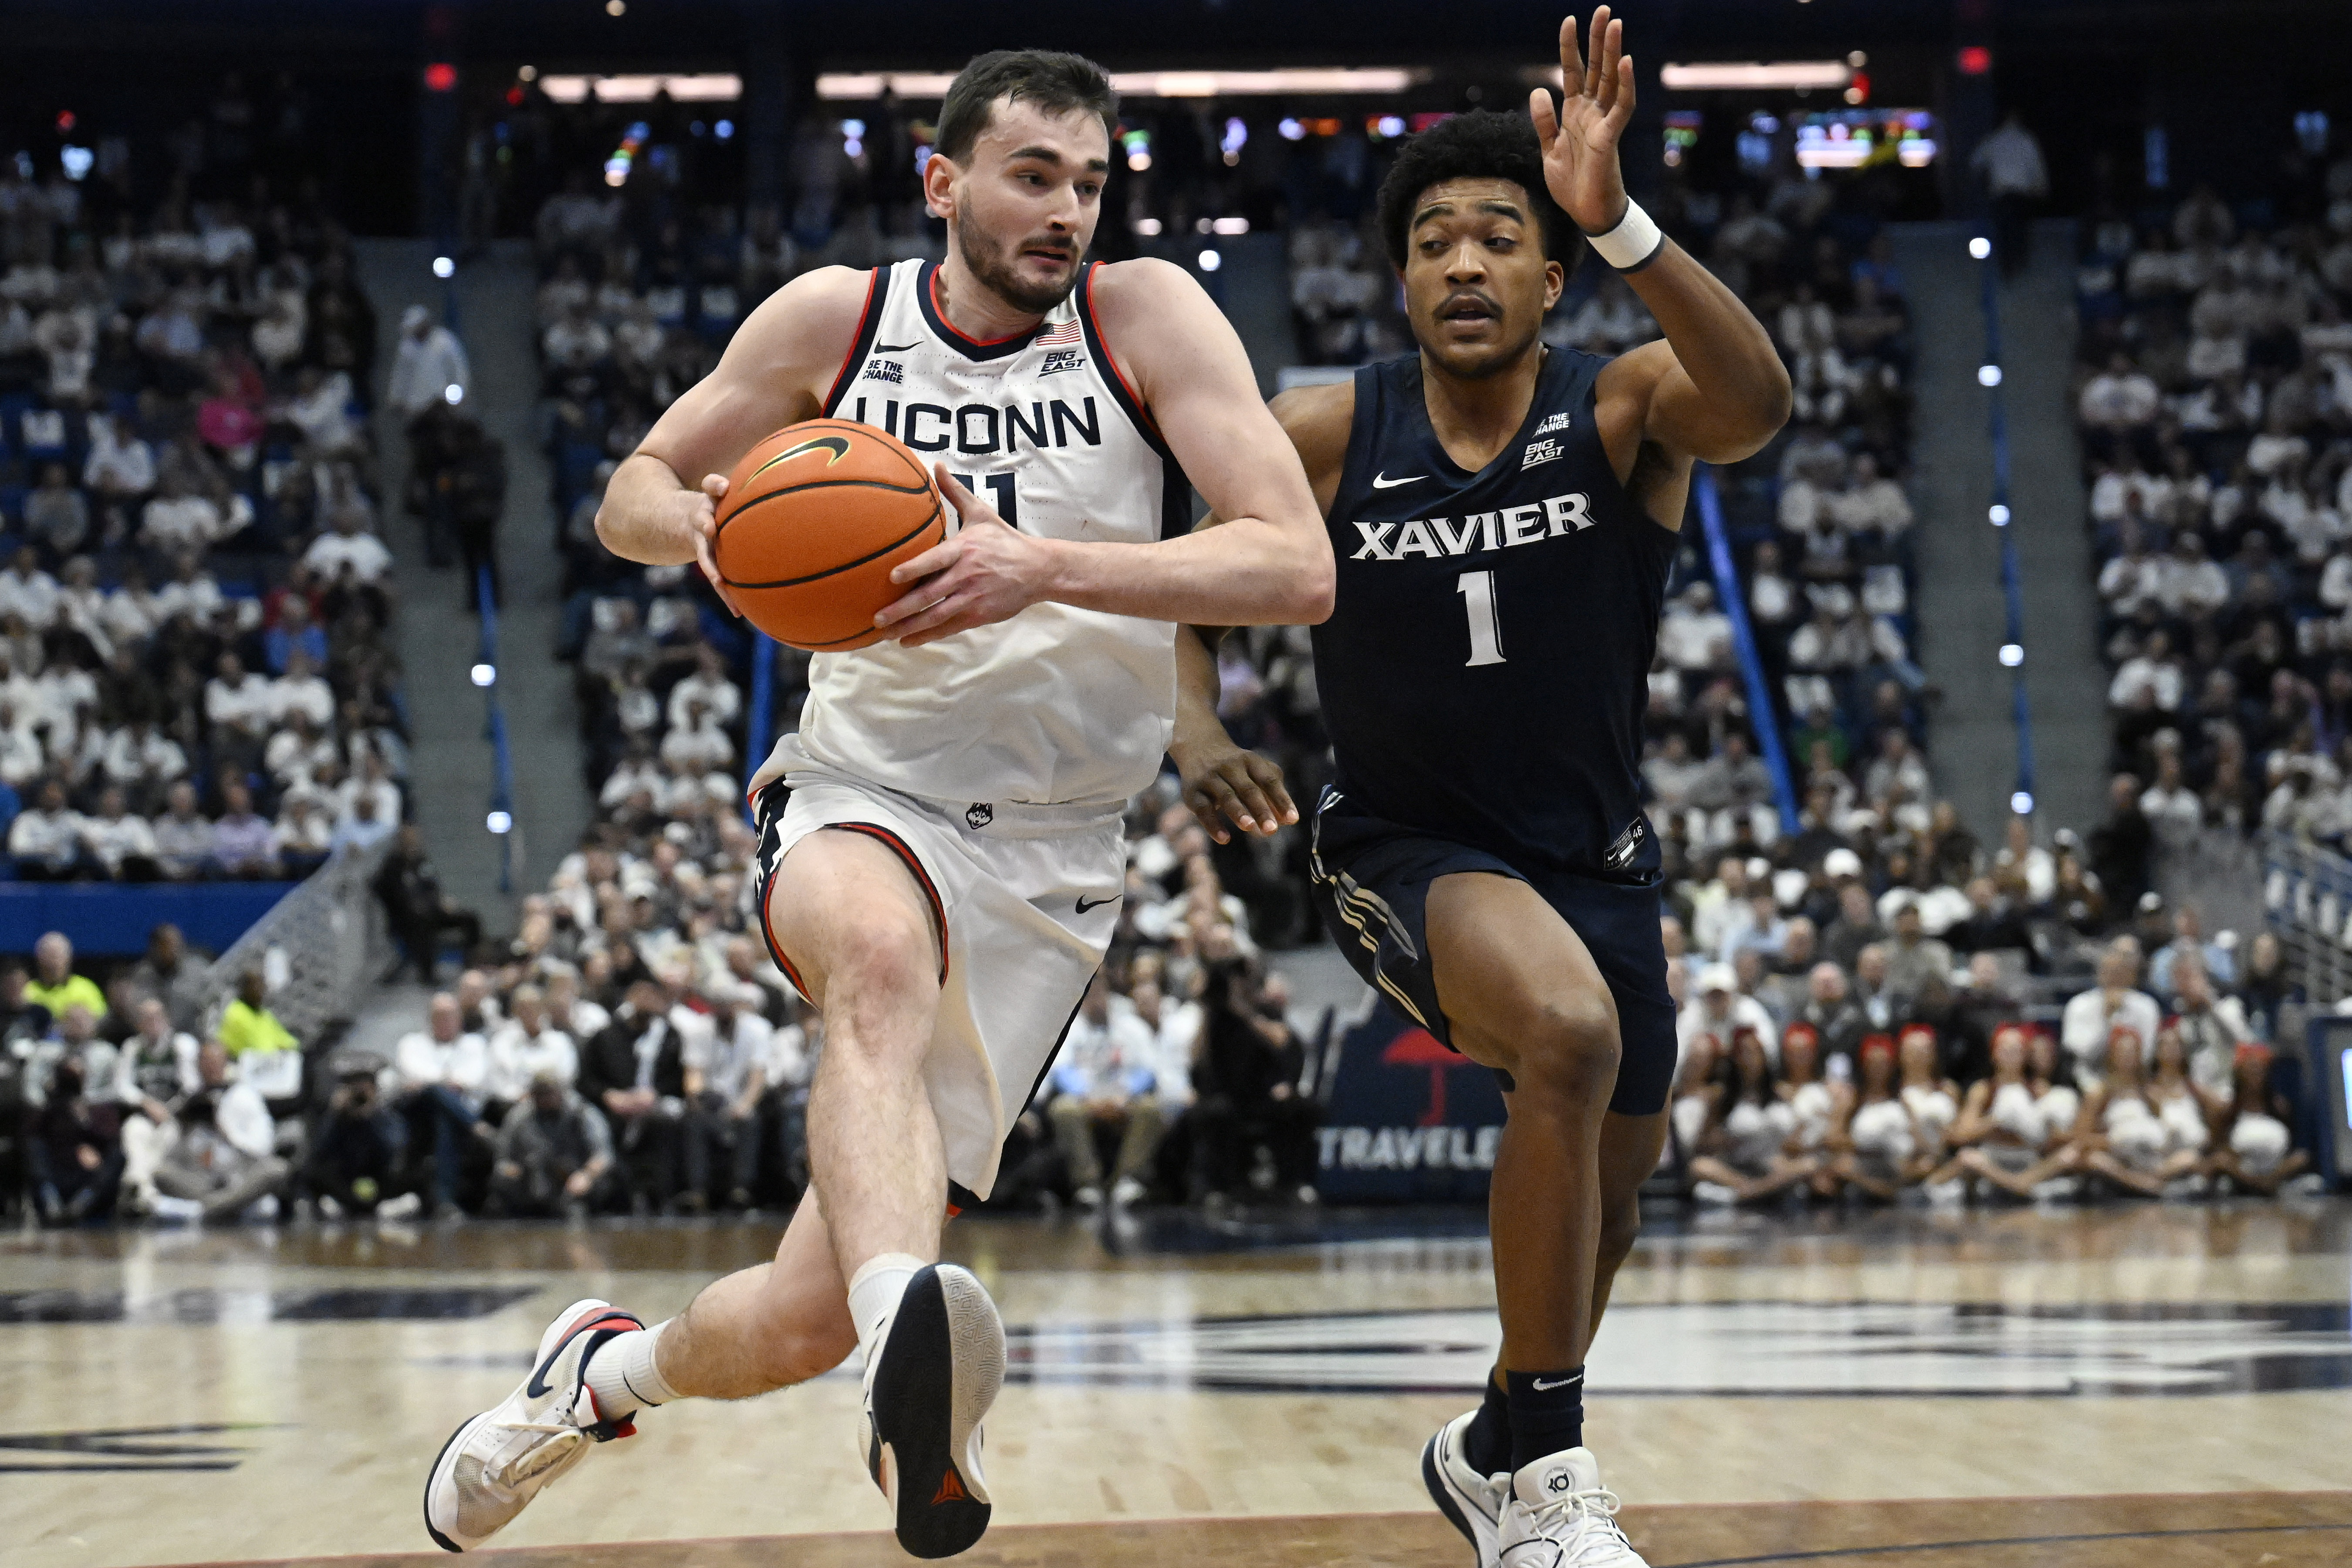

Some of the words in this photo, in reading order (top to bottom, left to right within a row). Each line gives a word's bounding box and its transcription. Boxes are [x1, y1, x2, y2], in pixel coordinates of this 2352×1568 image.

[1044, 350, 1077, 362] BIG
[868, 360, 882, 369] BE
[884, 361, 903, 374] THE
[1041, 359, 1086, 372] EAST
[862, 370, 903, 384] CHANGE
[1548, 413, 1568, 423] THE
[1532, 420, 1569, 438] HANGE
[1525, 438, 1555, 455] BIG
[1523, 446, 1565, 465] EAST
[1350, 492, 1598, 560] XAVIER
[1456, 570, 1507, 666] 1
[1633, 825, 1642, 838] 46
